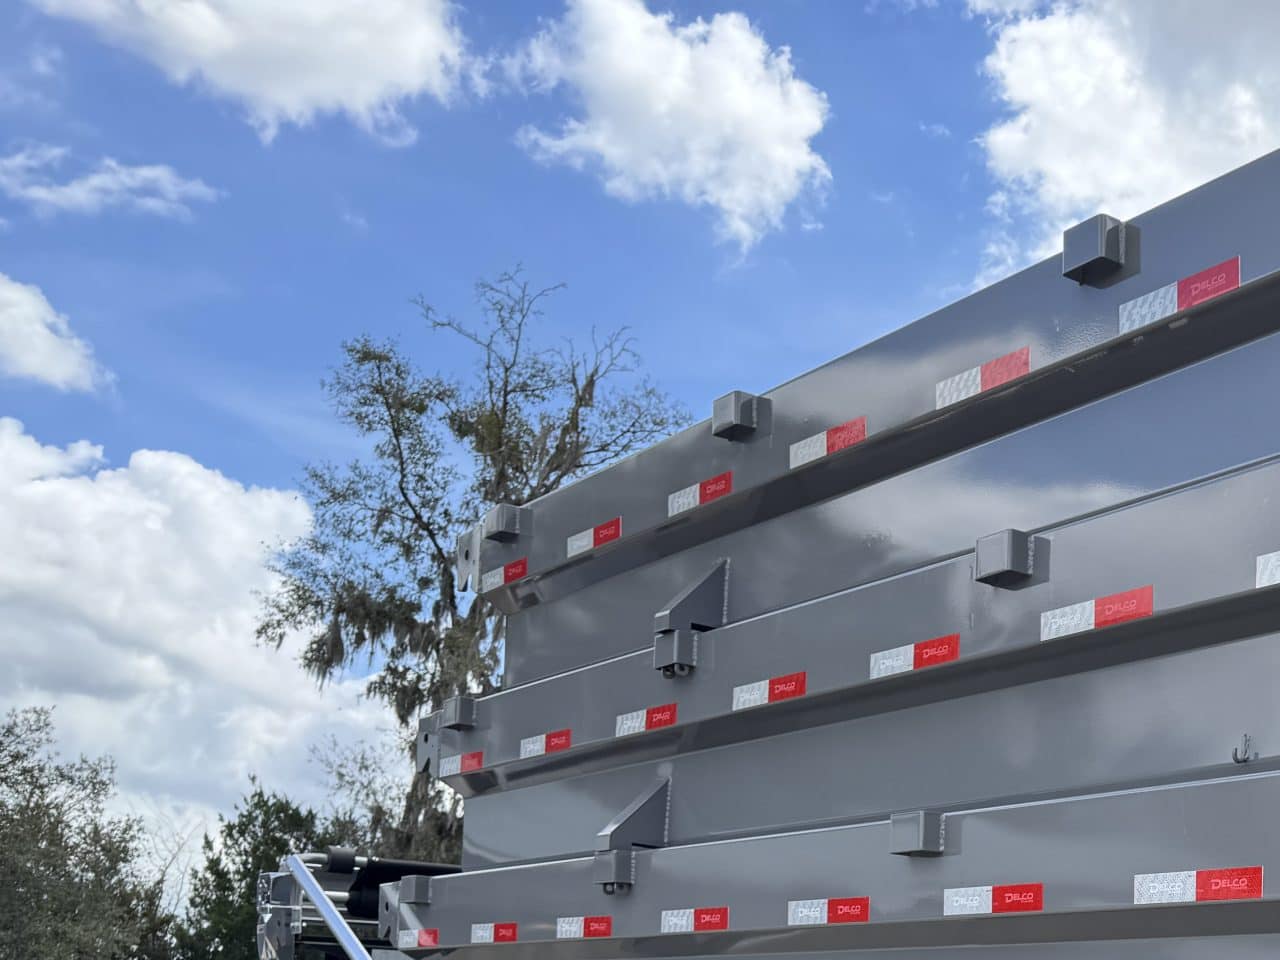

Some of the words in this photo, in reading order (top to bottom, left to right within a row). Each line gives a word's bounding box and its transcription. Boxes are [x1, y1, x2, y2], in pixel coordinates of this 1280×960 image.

[1190, 273, 1226, 297] DELCO
[1103, 599, 1137, 616] DELCO
[923, 645, 949, 659] DELCO
[1148, 882, 1184, 894] DELCO
[1210, 877, 1248, 890] DELCO
[1003, 892, 1034, 904] DELCO
[836, 904, 862, 915] DELCO
